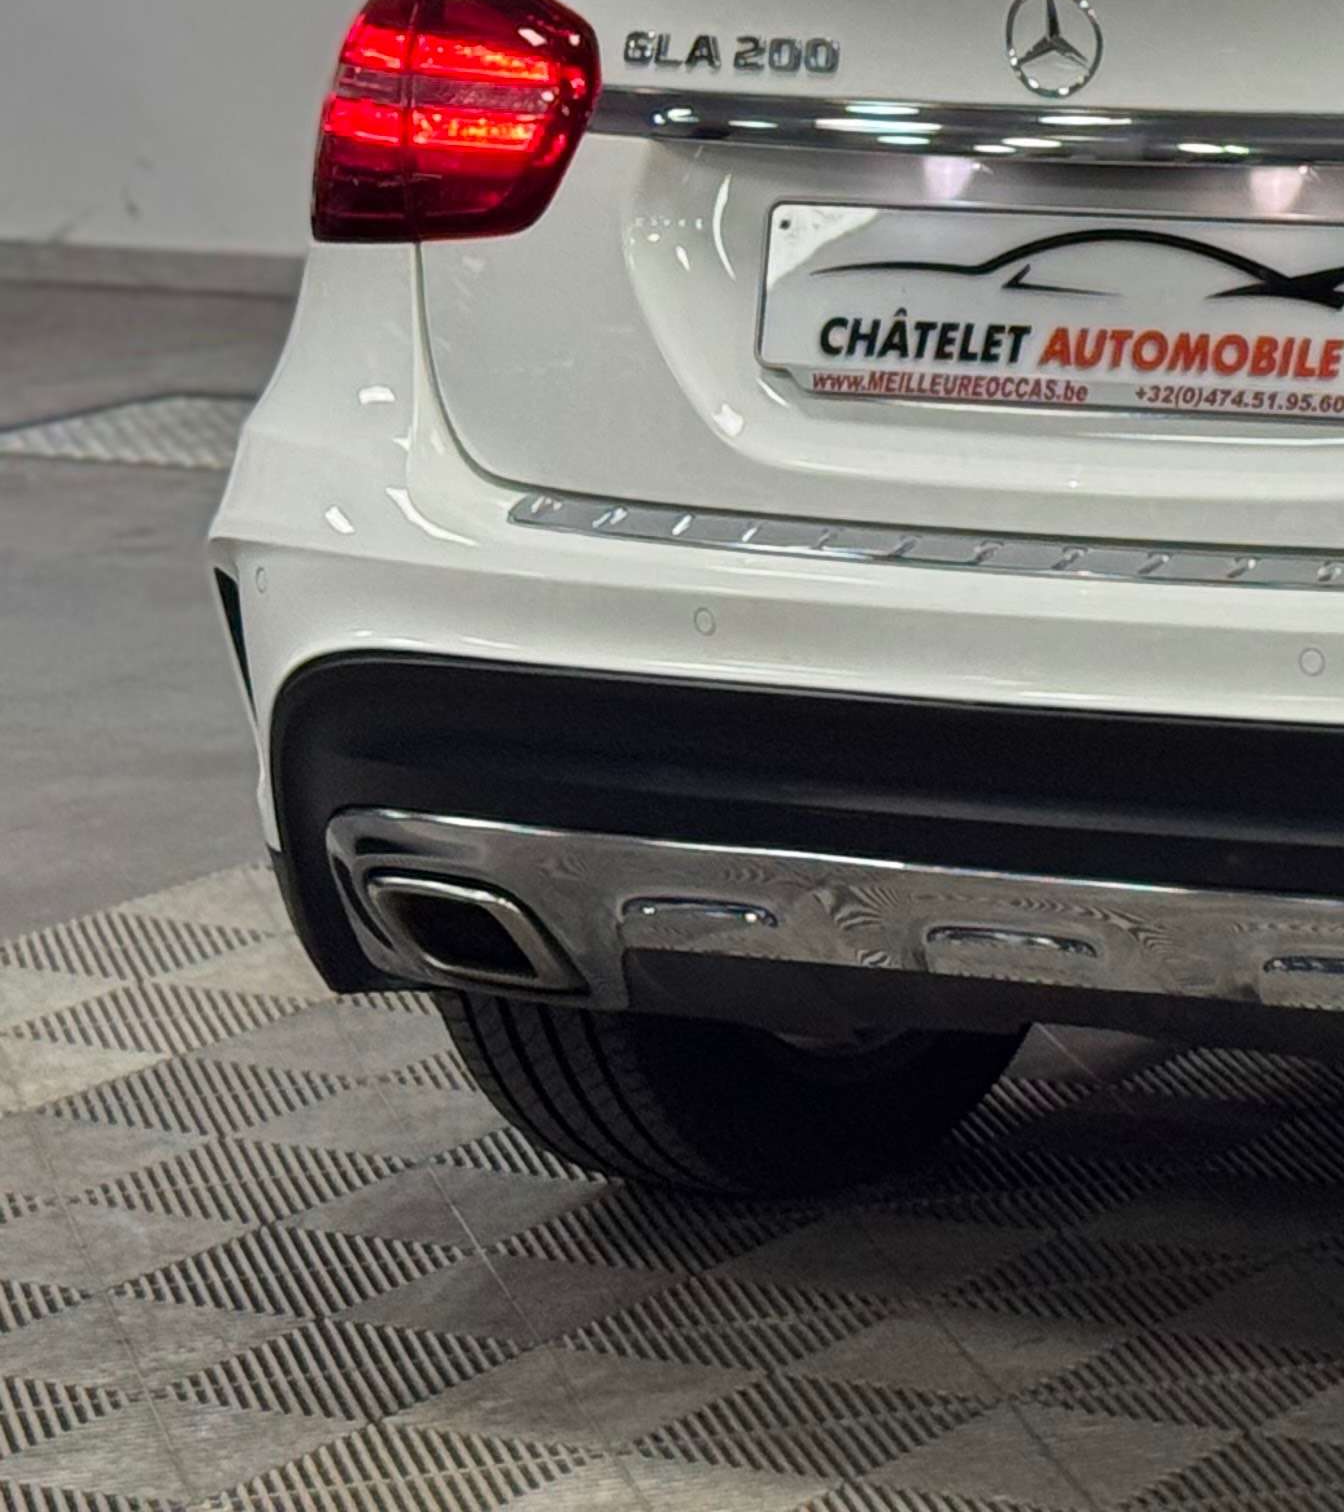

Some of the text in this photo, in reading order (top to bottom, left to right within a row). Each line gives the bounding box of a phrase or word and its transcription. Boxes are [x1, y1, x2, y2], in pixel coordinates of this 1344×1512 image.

[622, 30, 841, 74] GLA 200
[818, 307, 1032, 364] CHÂTELET
[811, 370, 1090, 403] www.MEILLEUREOCCAS.be
